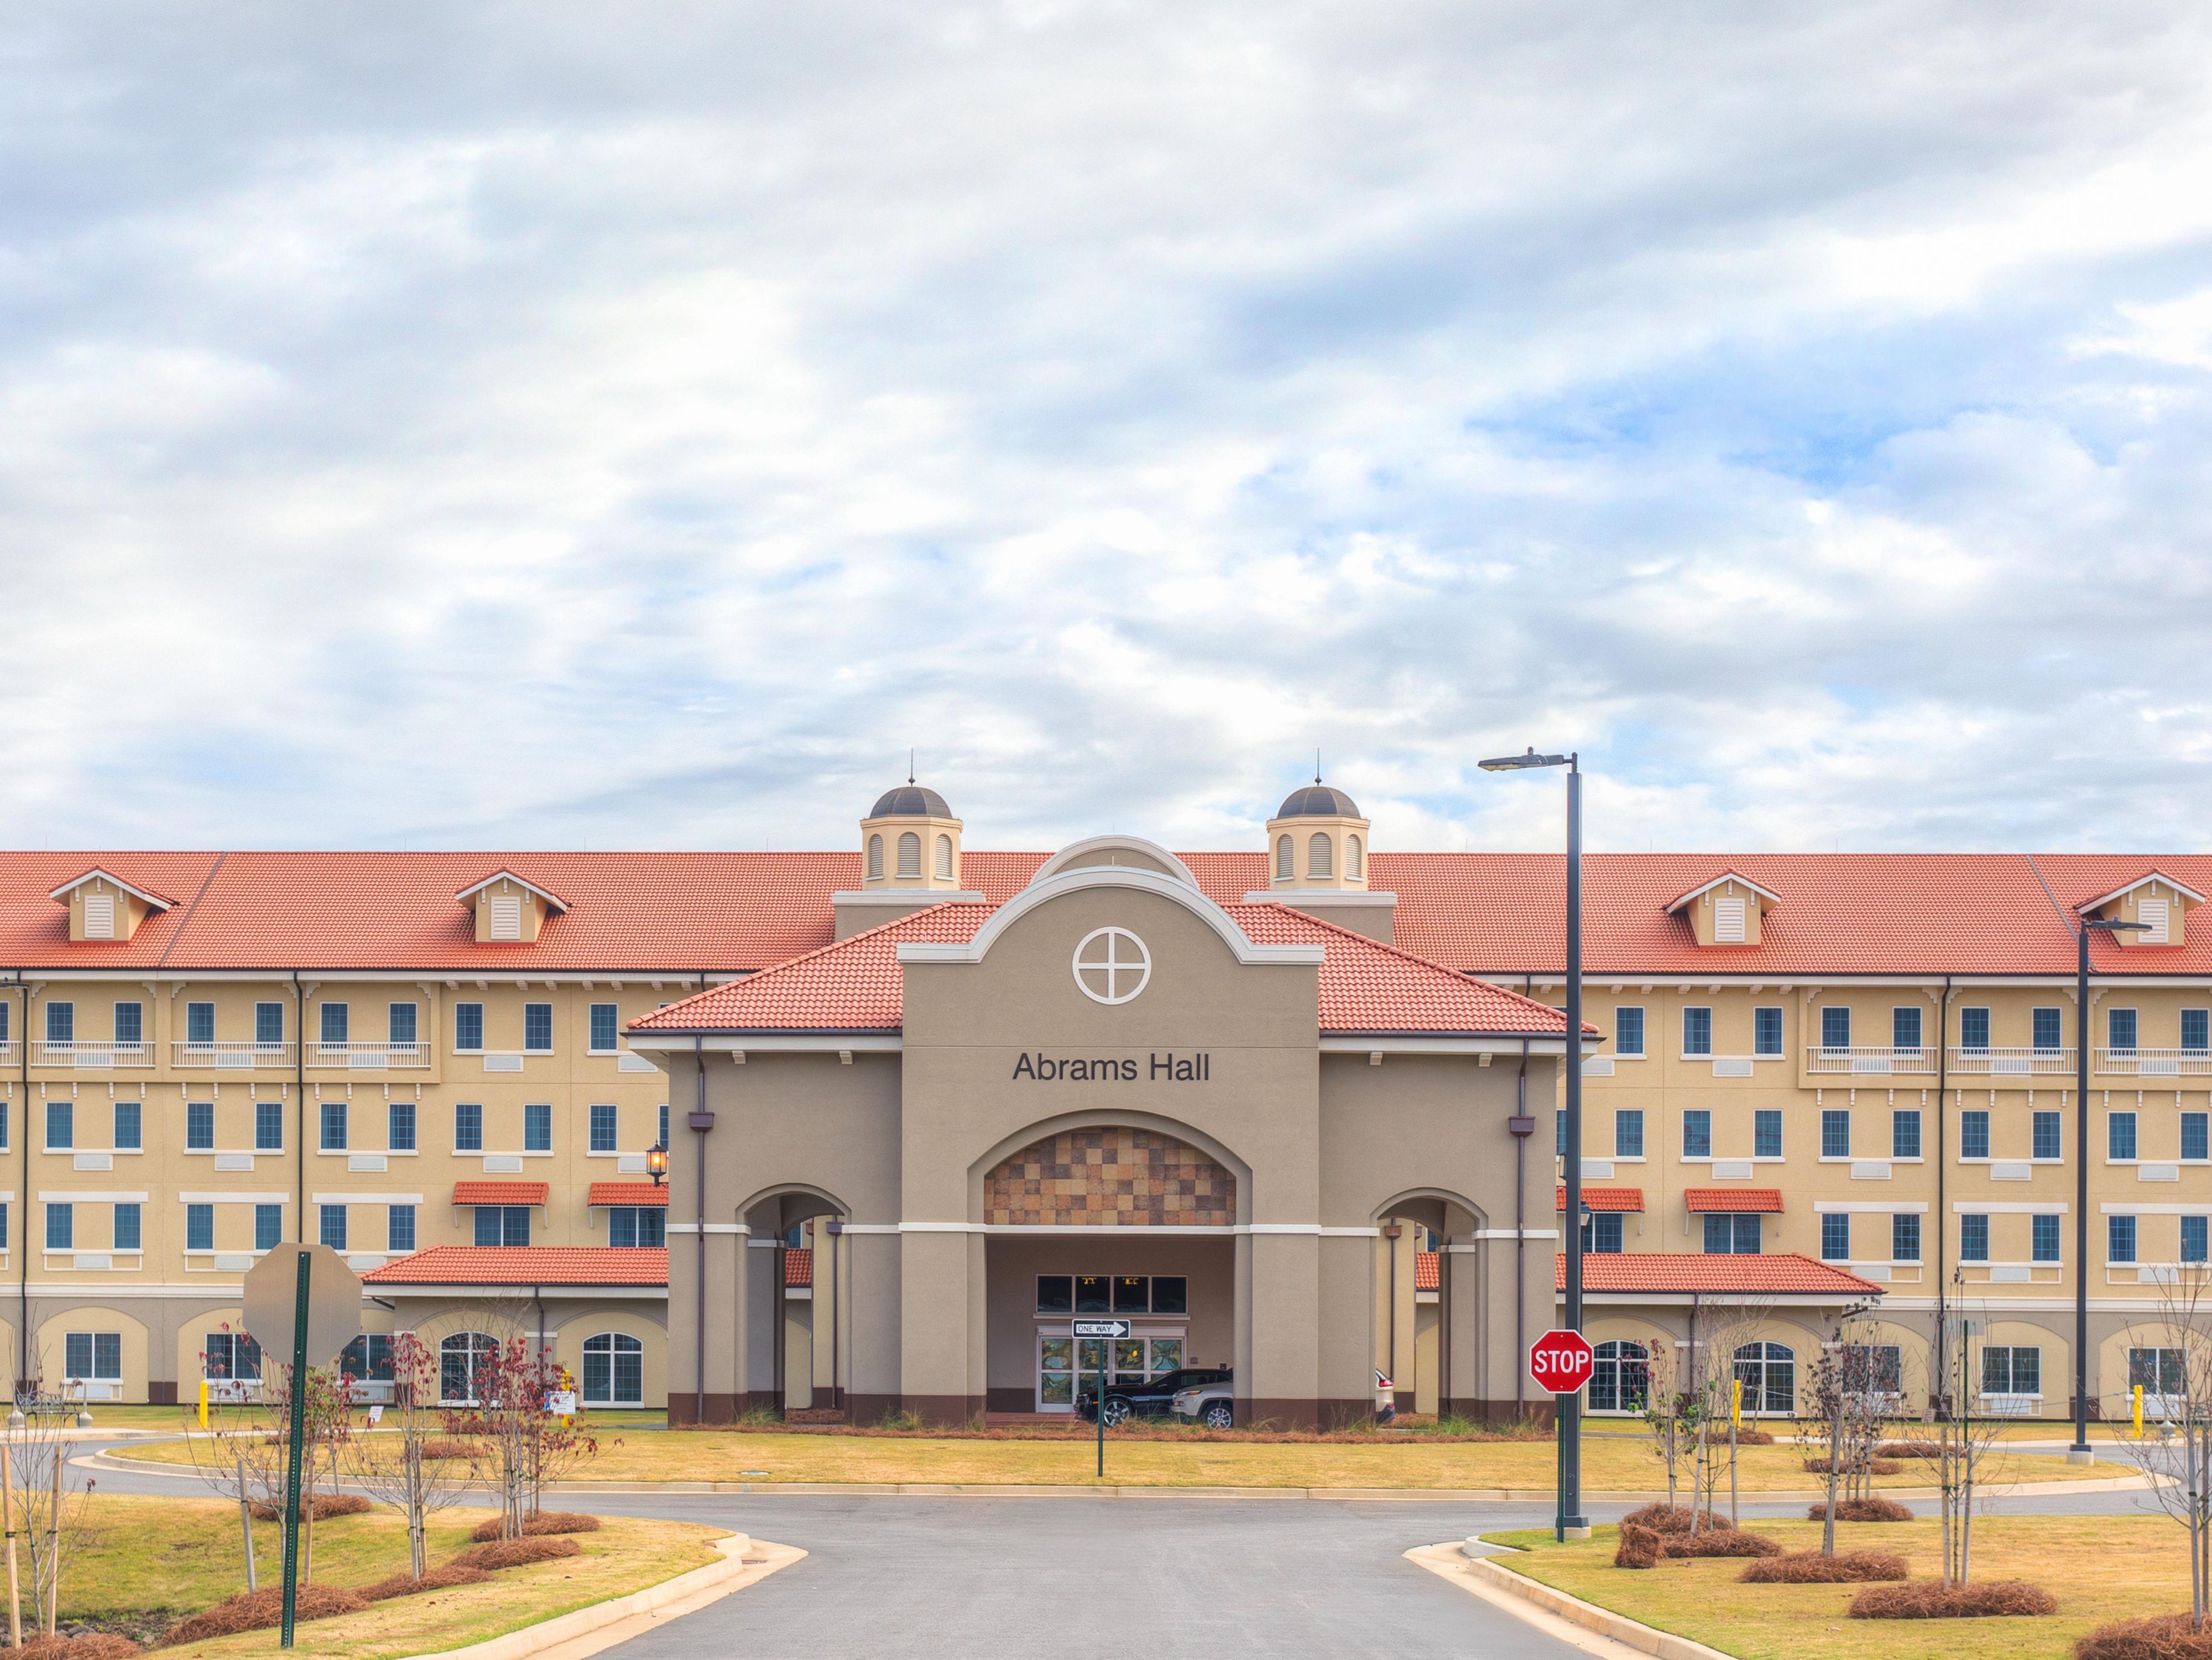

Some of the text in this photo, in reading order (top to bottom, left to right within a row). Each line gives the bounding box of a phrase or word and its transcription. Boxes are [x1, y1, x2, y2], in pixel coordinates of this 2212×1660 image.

[1012, 1053, 1209, 1081] Abrams Hall
[1534, 1350, 1589, 1373] STOP
